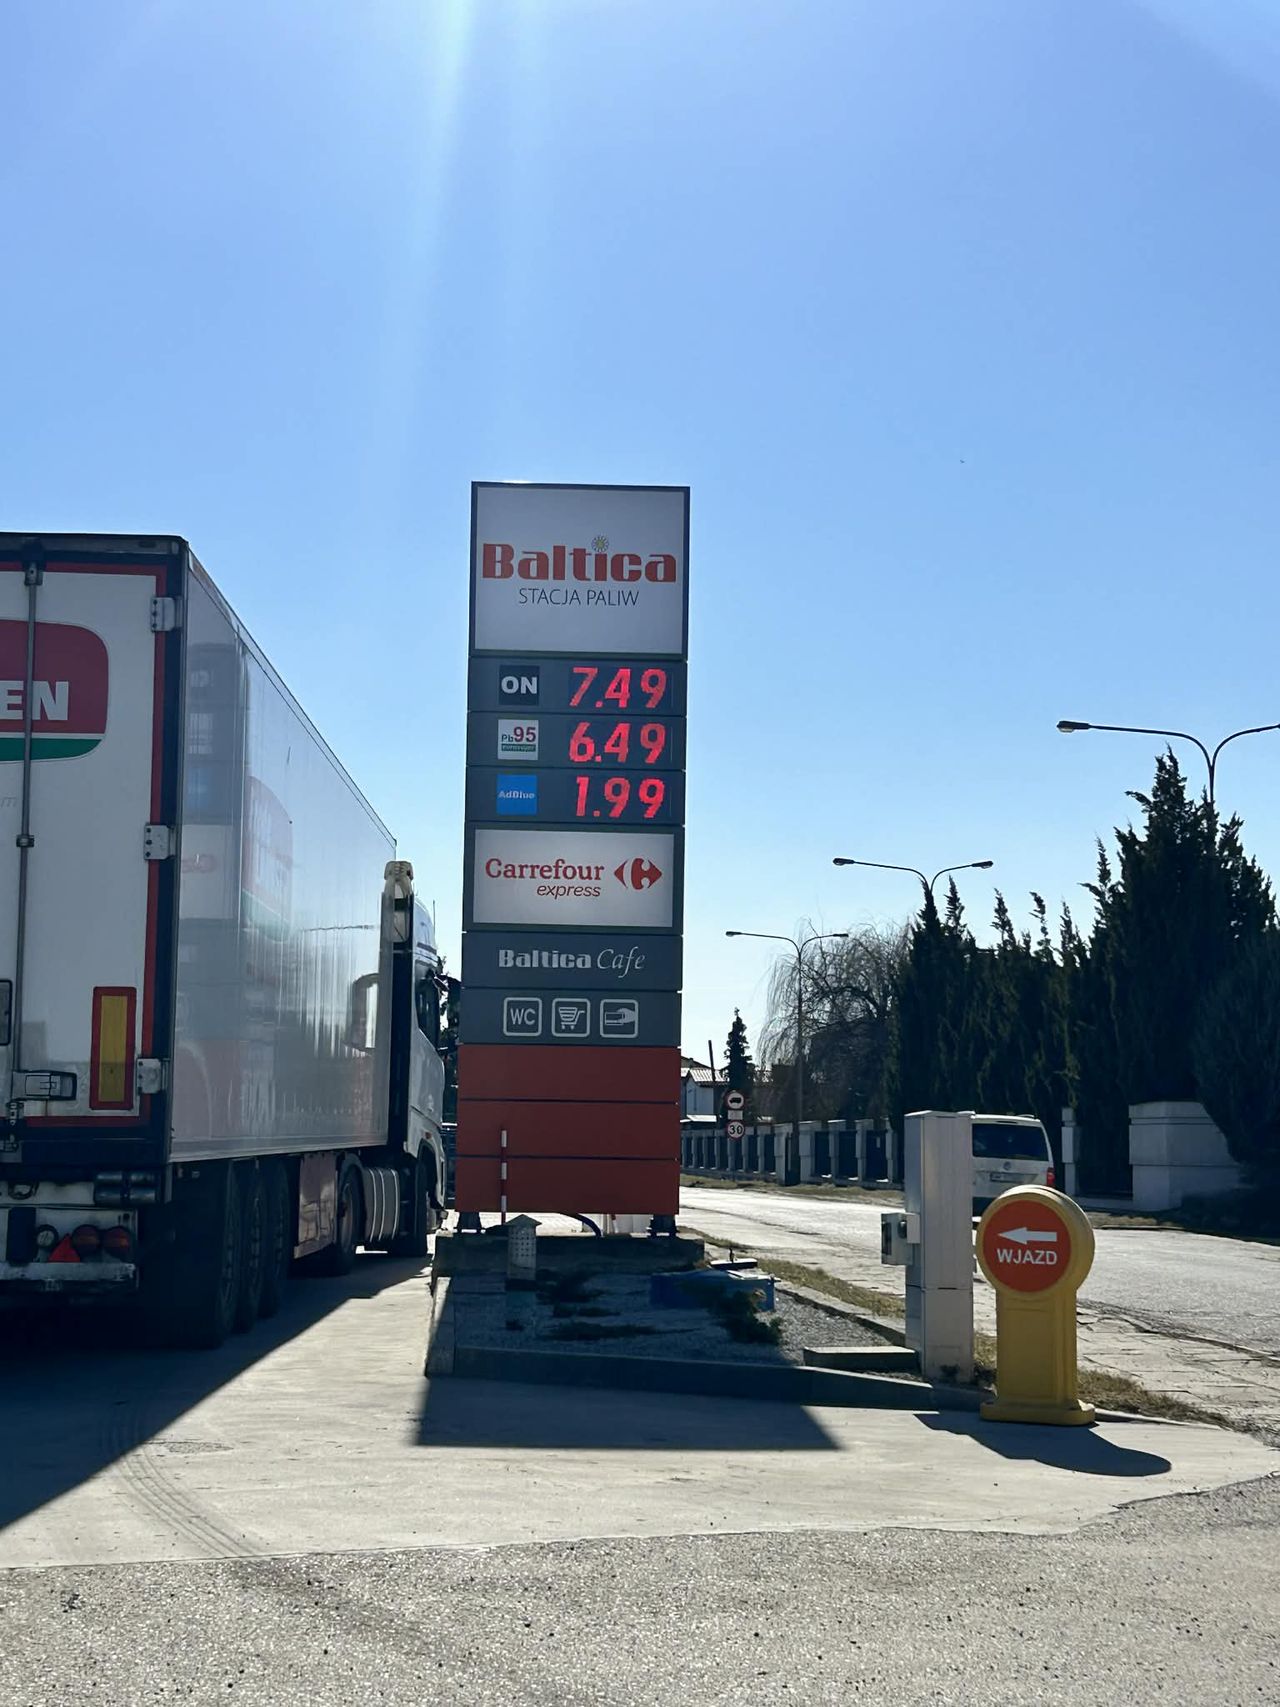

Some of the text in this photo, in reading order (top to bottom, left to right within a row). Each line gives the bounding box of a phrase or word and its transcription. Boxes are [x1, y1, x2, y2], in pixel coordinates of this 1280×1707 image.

[482, 536, 677, 583] Baltica
[519, 588, 640, 606] STACJA PALIW
[501, 676, 538, 694] ON
[569, 667, 667, 709] 7.49
[569, 721, 667, 764] 6.49
[499, 790, 536, 800] AdBlue
[576, 776, 666, 818] 1.99
[485, 858, 605, 881] Carrefour
[536, 884, 601, 900] express
[498, 946, 647, 979] Baltica Cafe
[509, 1007, 537, 1026] WC
[730, 1125, 743, 1135] 30
[996, 1248, 1058, 1265] WJAZD
